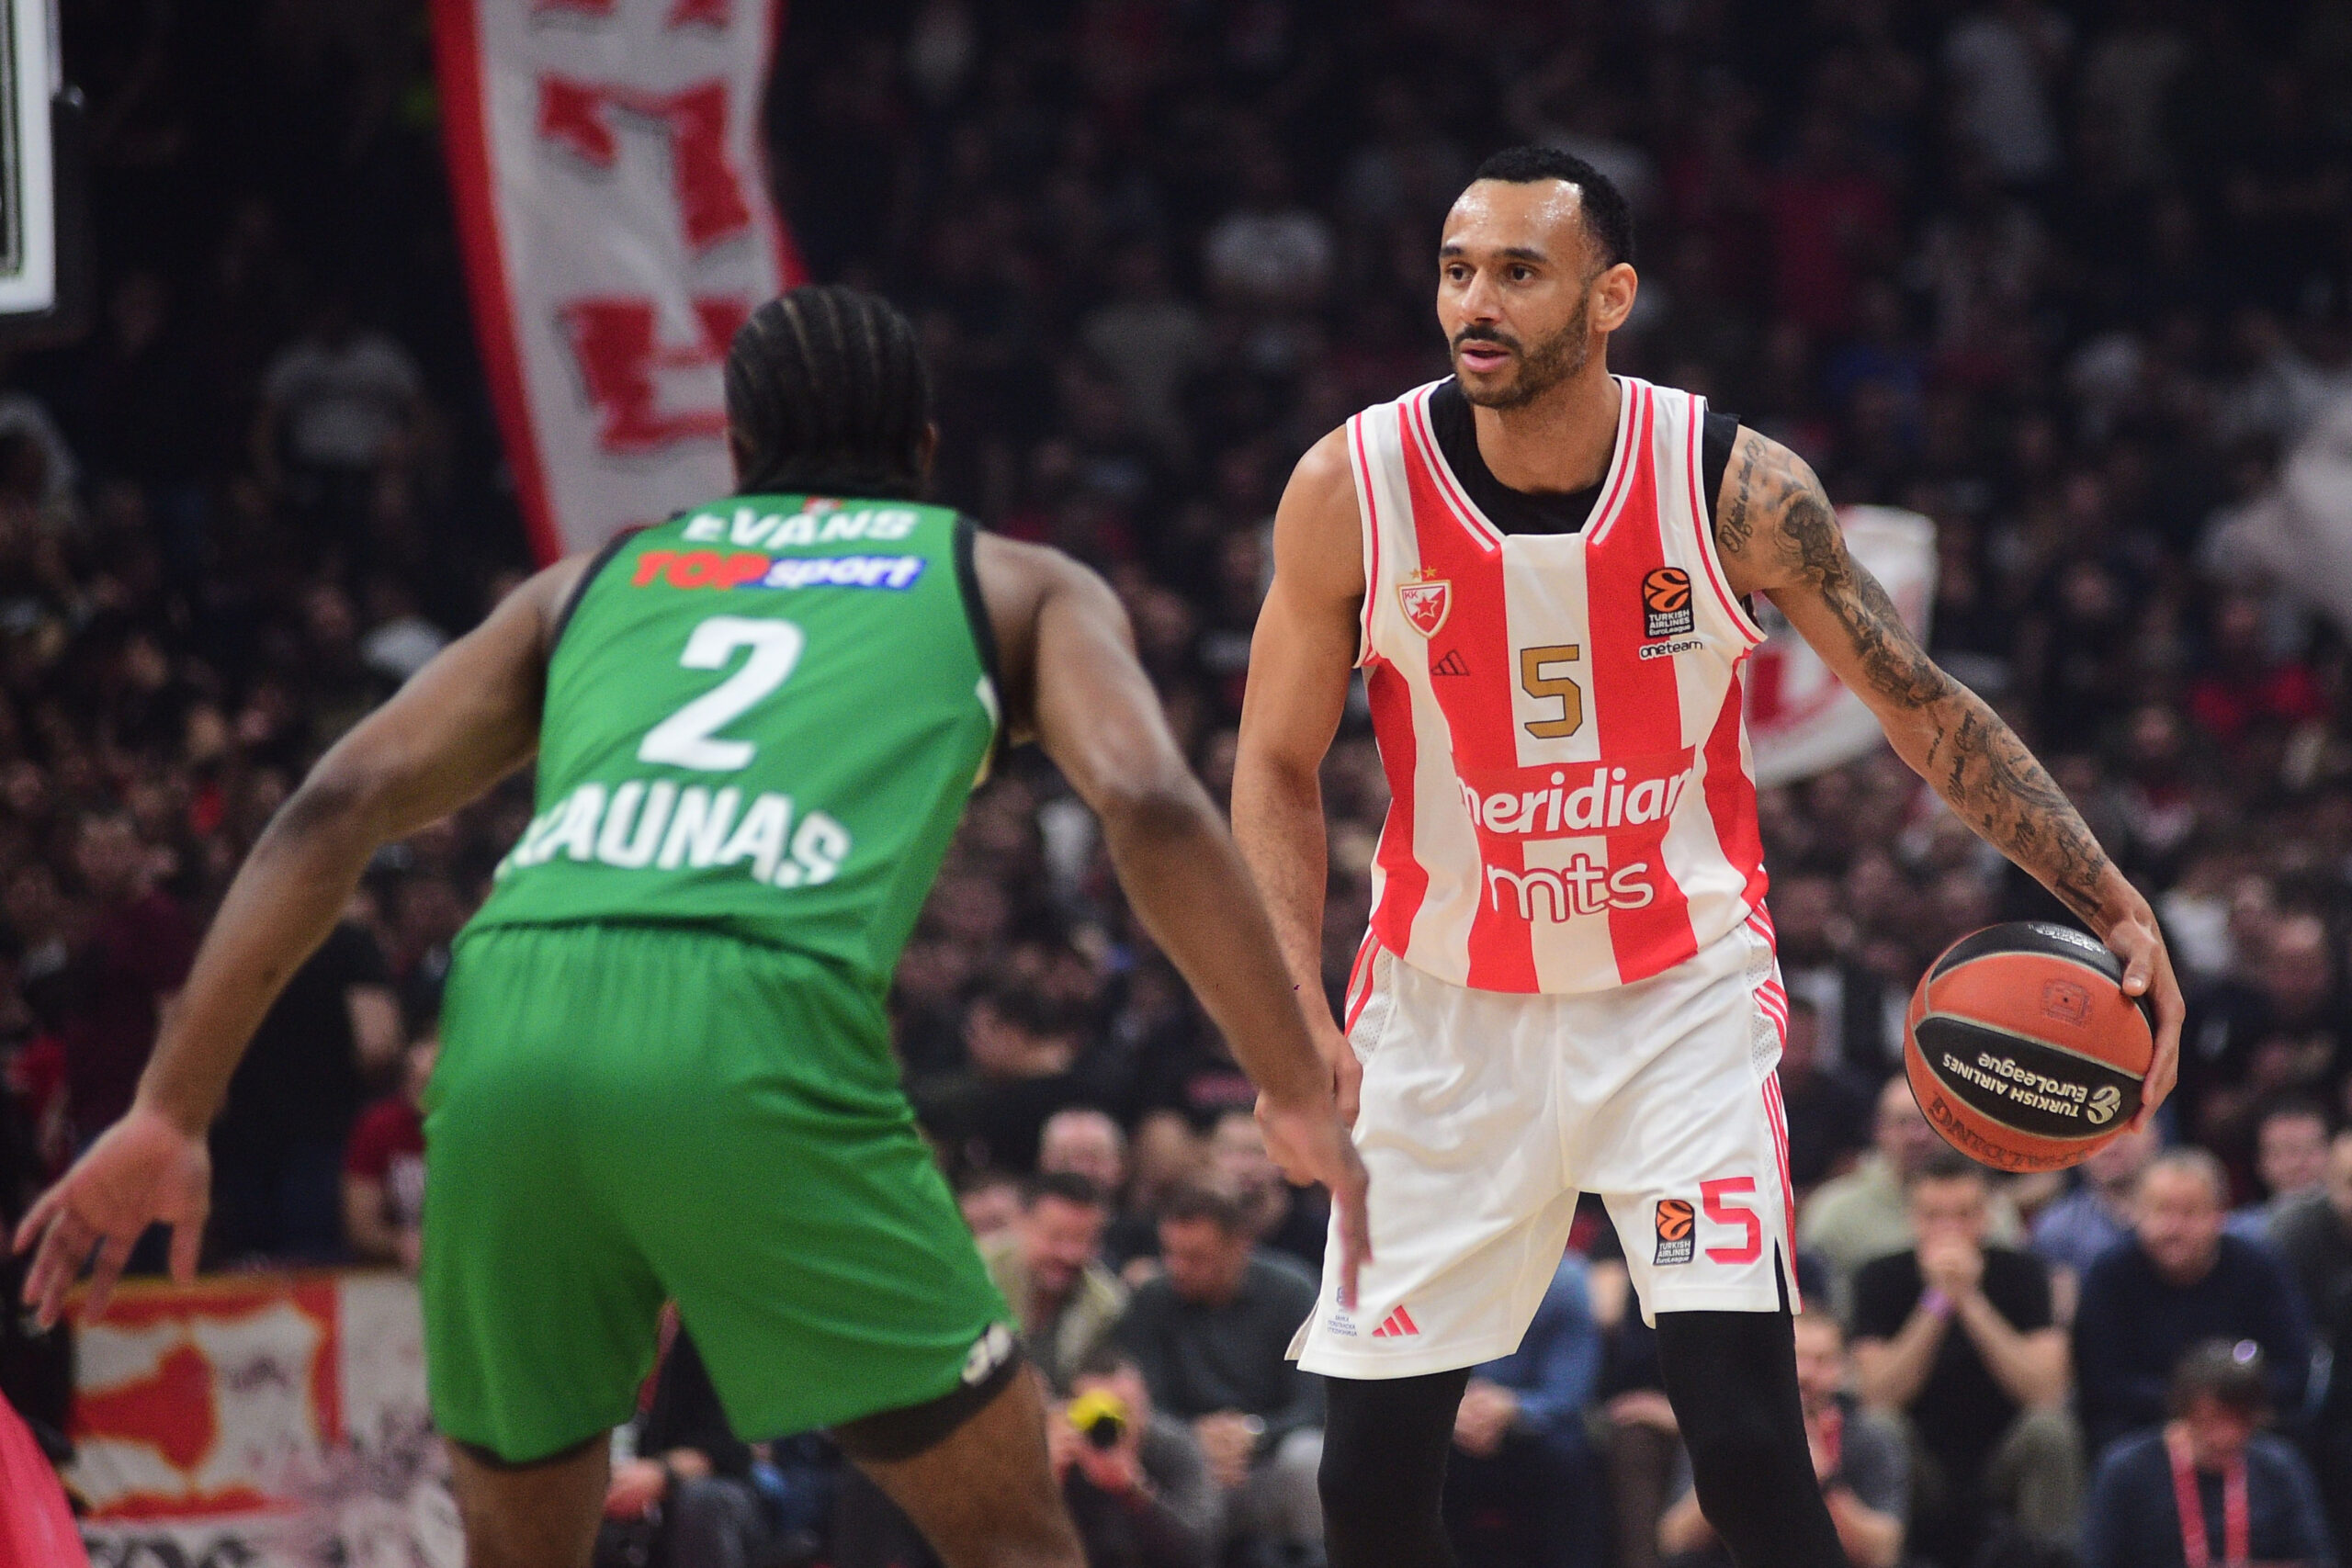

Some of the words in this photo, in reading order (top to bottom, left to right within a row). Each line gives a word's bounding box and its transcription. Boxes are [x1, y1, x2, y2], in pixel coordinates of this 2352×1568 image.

[684, 508, 917, 547] EVANS
[632, 550, 920, 590] TOPsport
[1649, 610, 1690, 622] TURKISH
[1649, 616, 1690, 629] AIRLINES
[1649, 625, 1691, 637] EuroLeague
[639, 616, 805, 770] 2
[1520, 644, 1583, 739] 5
[1487, 852, 1654, 923] mts
[1942, 1052, 2008, 1095] AIRLINES
[1978, 1052, 2088, 1103] EuroLeague
[2009, 1087, 2079, 1118] TURKISH
[1930, 1094, 2092, 1168] ALDING
[1700, 1177, 1761, 1264] 5
[1658, 1248, 1690, 1258] AIRLINES
[1659, 1240, 1691, 1250] TURKISH
